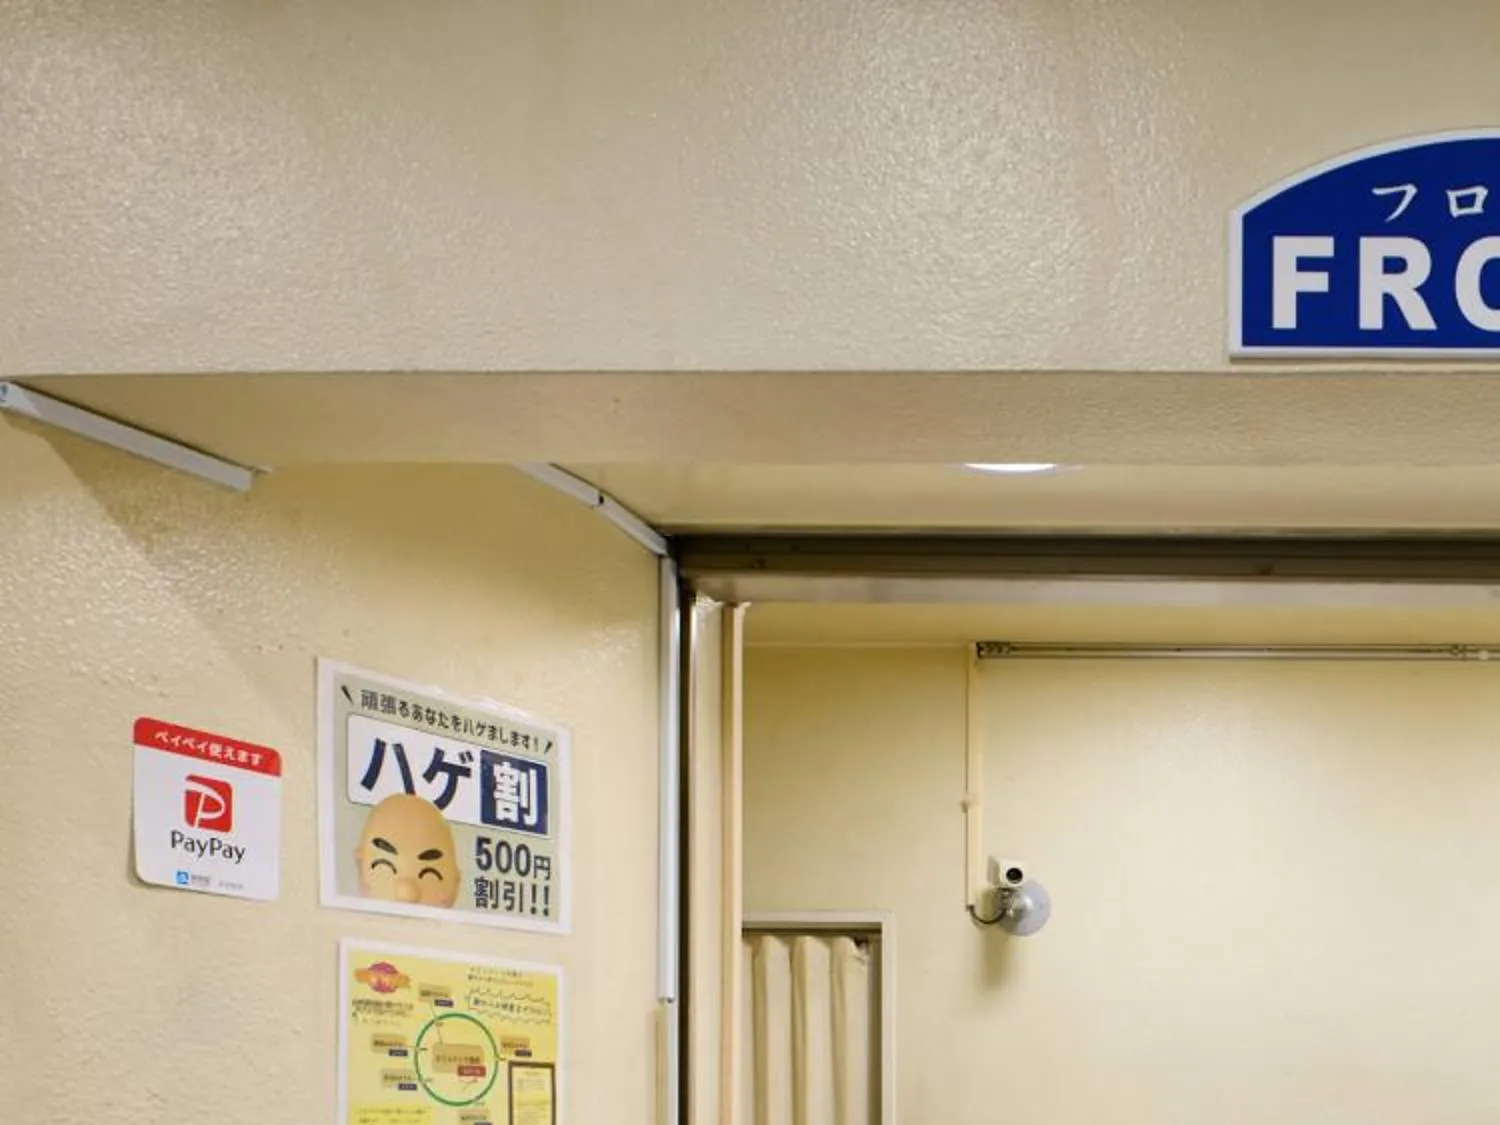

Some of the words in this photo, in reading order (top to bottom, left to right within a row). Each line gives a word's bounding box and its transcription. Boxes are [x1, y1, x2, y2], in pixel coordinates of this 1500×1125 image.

[154, 730, 264, 766] ペイペイ使えます
[170, 830, 247, 865] PayPay
[475, 836, 551, 881] 500円
[474, 876, 550, 916] 割引!!
